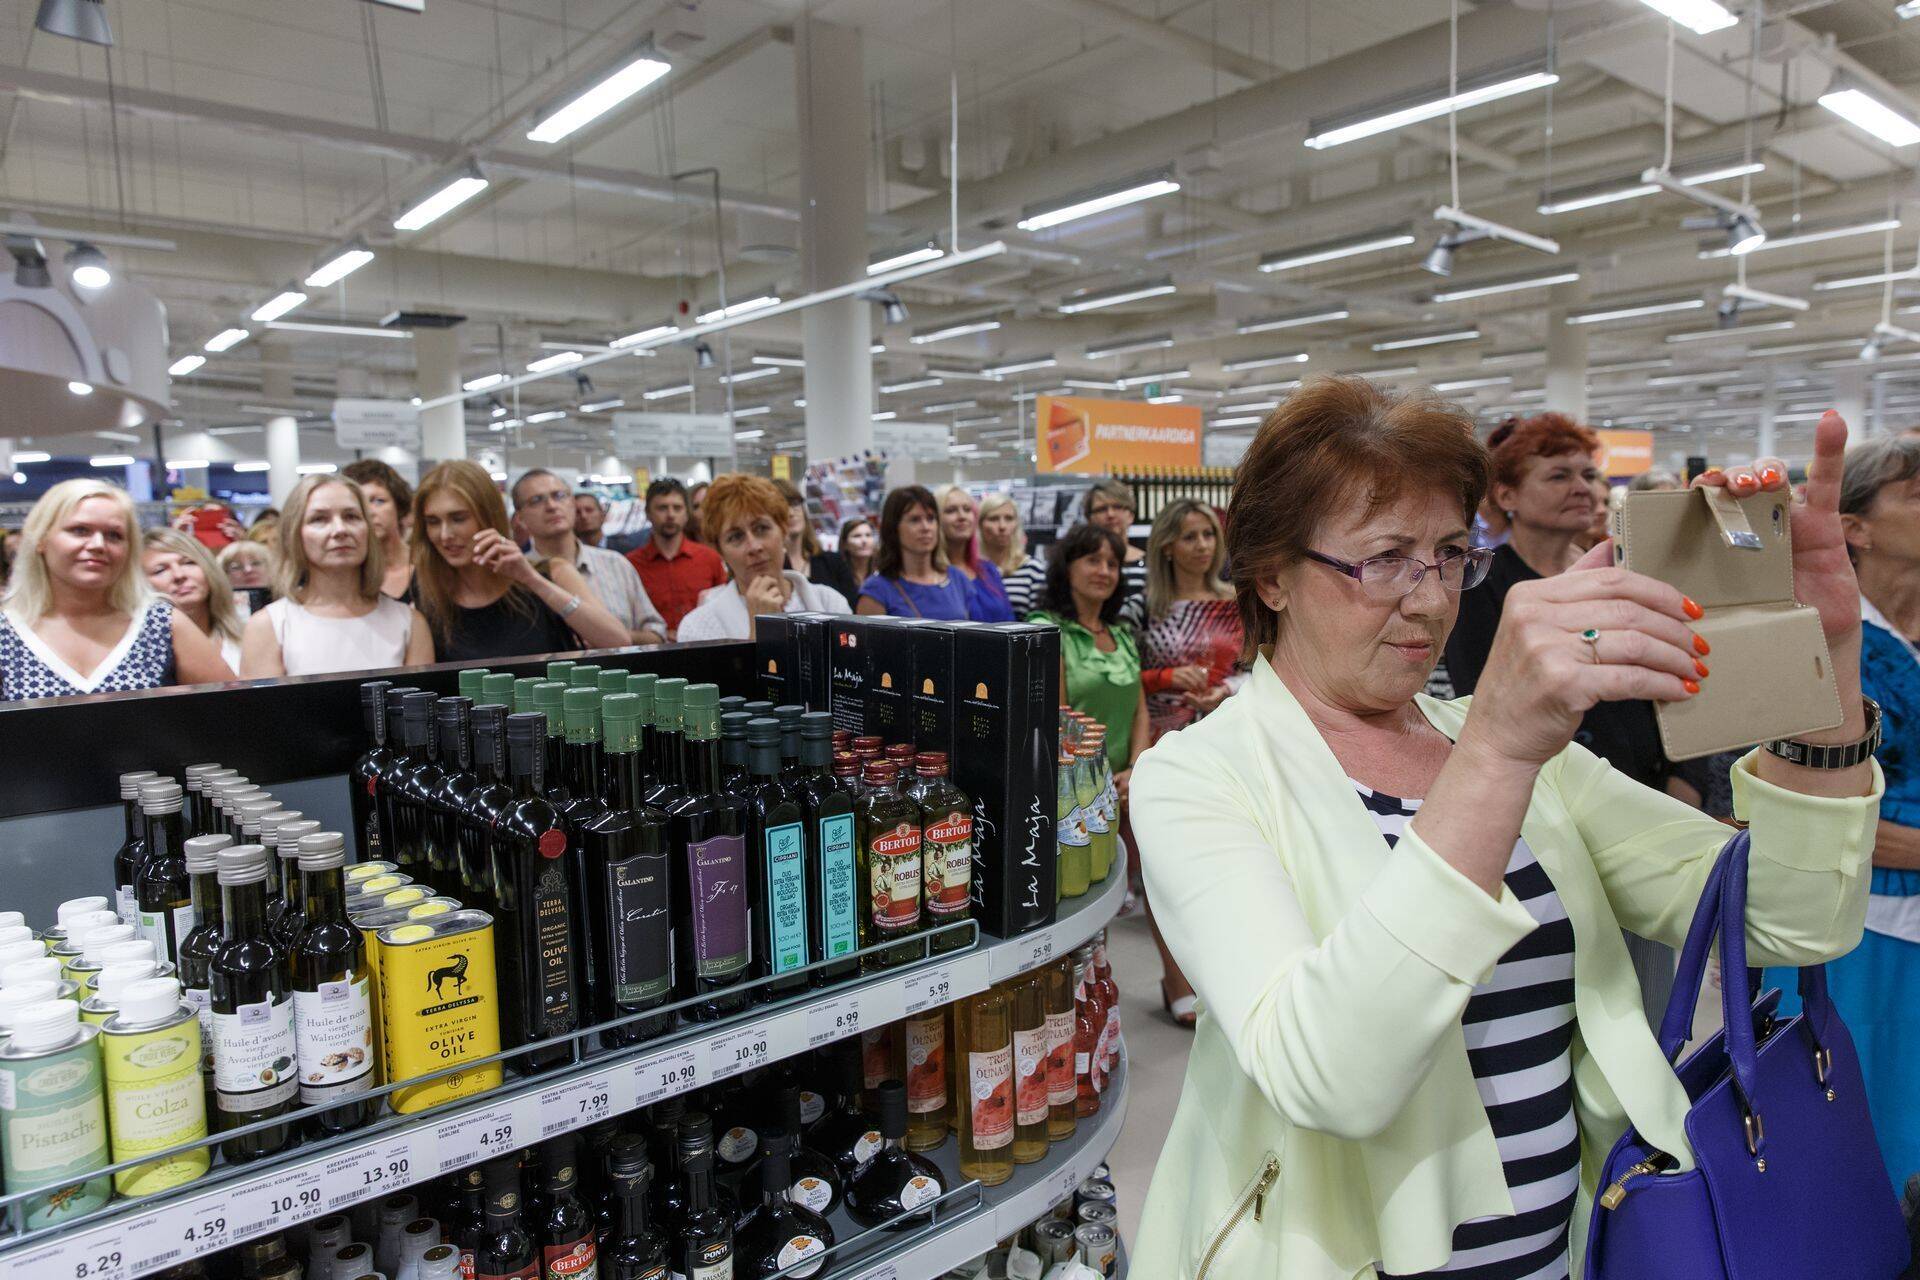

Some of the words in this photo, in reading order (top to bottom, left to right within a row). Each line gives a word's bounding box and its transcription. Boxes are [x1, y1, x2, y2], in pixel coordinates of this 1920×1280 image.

[1021, 795, 1050, 867] Maja
[697, 856, 732, 866] GALANTINO
[617, 876, 654, 887] GALANTINO
[1022, 875, 1038, 907] La
[540, 906, 566, 917] DELYSSA
[543, 899, 562, 908] TERRA
[542, 923, 566, 933] ORGANIC
[543, 945, 568, 958] OLIVE
[1033, 943, 1052, 958] 25.90
[549, 958, 563, 967] OIL
[930, 981, 949, 997] 5.99
[425, 1004, 446, 1014] TERRA
[448, 998, 475, 1009] DELYSSA
[307, 1018, 333, 1027] Huile
[336, 1015, 347, 1023] de
[425, 1022, 448, 1032] EXTRA
[451, 1015, 477, 1025] VIRGIN
[836, 1011, 859, 1027] 8.99
[224, 1038, 250, 1047] Huile
[430, 1031, 475, 1050] OLIVE
[441, 1044, 465, 1058] OIL
[736, 1041, 767, 1061] 10.90
[661, 1065, 695, 1086] 10.90
[136, 1097, 190, 1120] Colza
[579, 1093, 609, 1113] 7.99
[20, 1118, 99, 1150] Pistache
[438, 1124, 457, 1134] EKSTRA
[438, 1129, 460, 1139] SUBLIME
[480, 1125, 512, 1146] 4.59
[363, 1159, 409, 1185] 13.90
[382, 1181, 401, 1191] 55.60
[271, 1188, 320, 1215] 10.90
[291, 1210, 311, 1221] 43.60
[184, 1217, 226, 1242] 4.59
[703, 1244, 728, 1260] PONTI
[76, 1251, 122, 1279] 8.29
